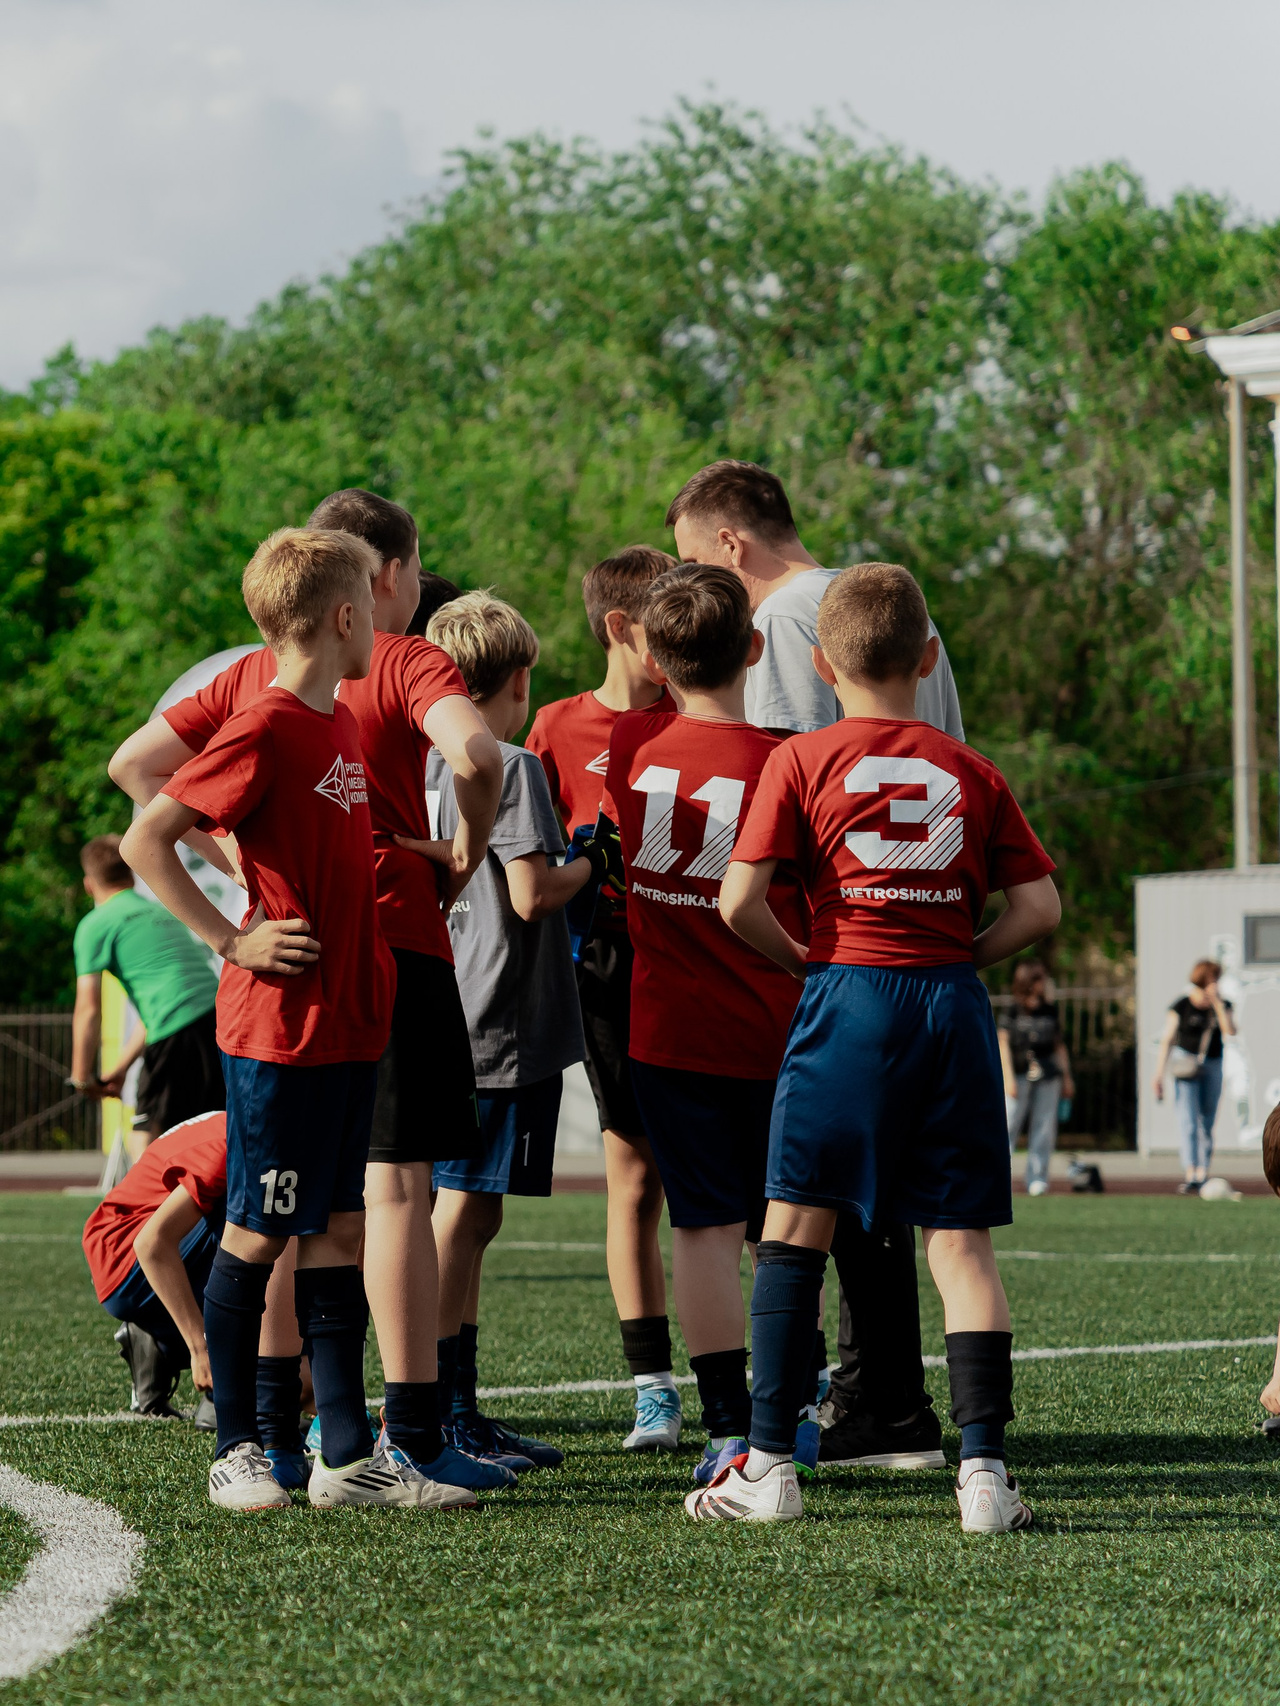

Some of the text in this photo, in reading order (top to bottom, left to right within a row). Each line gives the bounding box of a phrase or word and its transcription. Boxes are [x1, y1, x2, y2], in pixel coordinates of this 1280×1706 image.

[630, 764, 746, 881] 11
[843, 755, 964, 870] 3
[840, 887, 962, 903] METROSHKA.RU
[260, 1169, 298, 1215] 13
